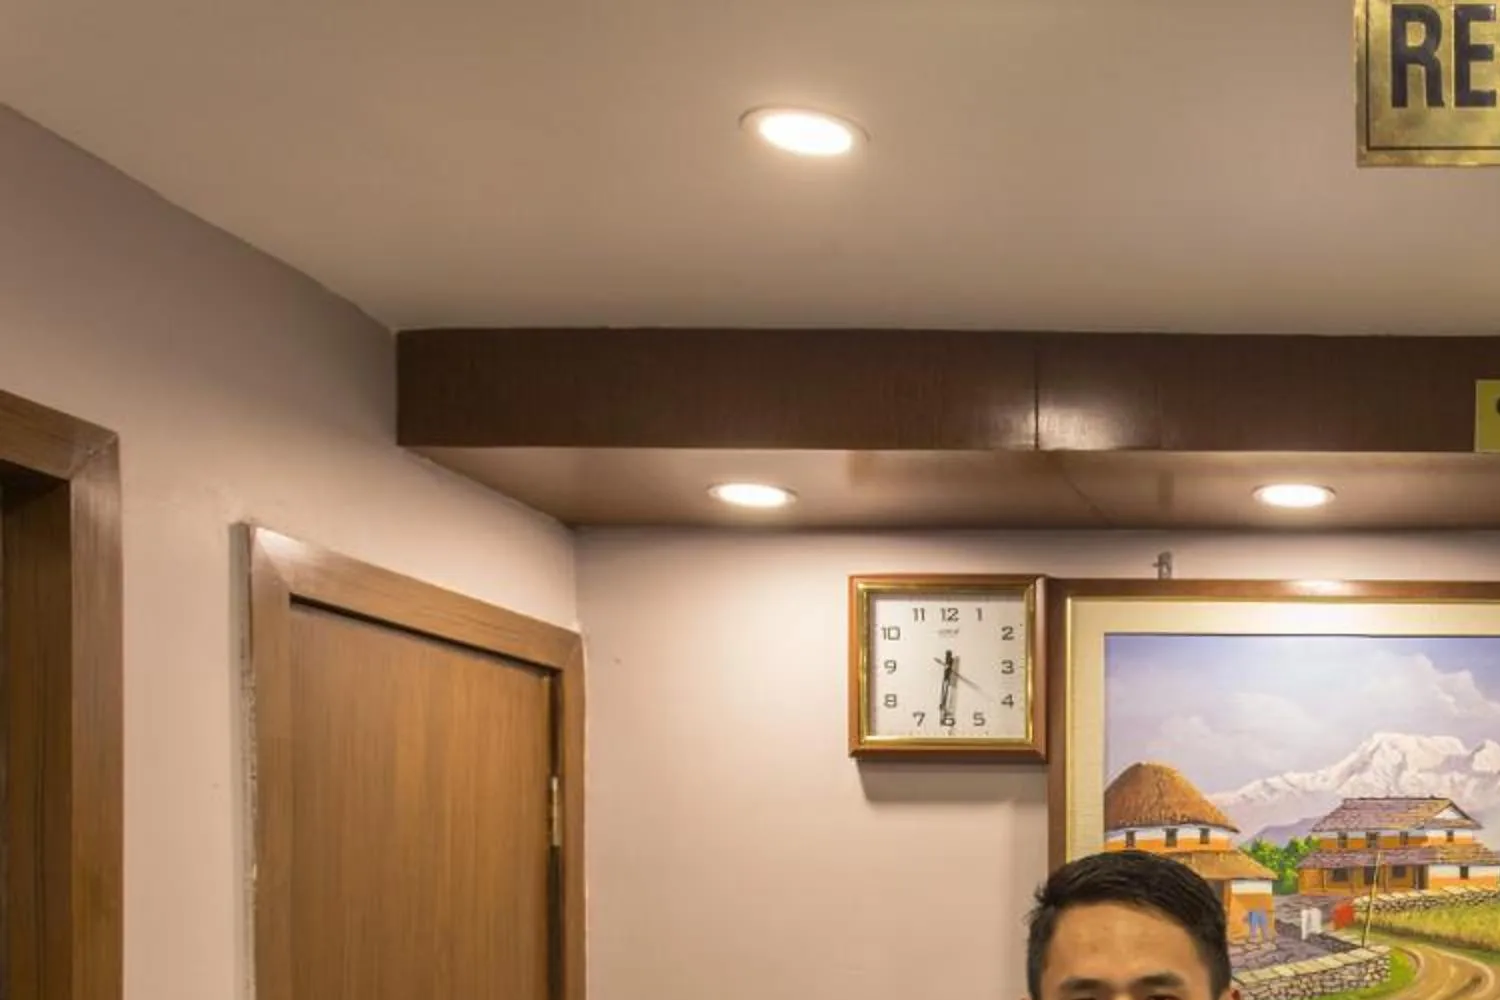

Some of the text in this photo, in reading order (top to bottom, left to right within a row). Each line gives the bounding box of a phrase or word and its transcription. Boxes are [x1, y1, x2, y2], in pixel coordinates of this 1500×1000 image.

[913, 608, 925, 621] 11
[941, 608, 959, 621] 12
[976, 608, 983, 620] 1
[881, 626, 900, 640] 10
[1001, 626, 1014, 640] 2
[884, 660, 897, 674] 9
[1001, 661, 1014, 674] 3
[884, 694, 897, 708] 8
[1001, 694, 1014, 708] 4
[913, 712, 925, 726] 7
[973, 713, 985, 726] 5
